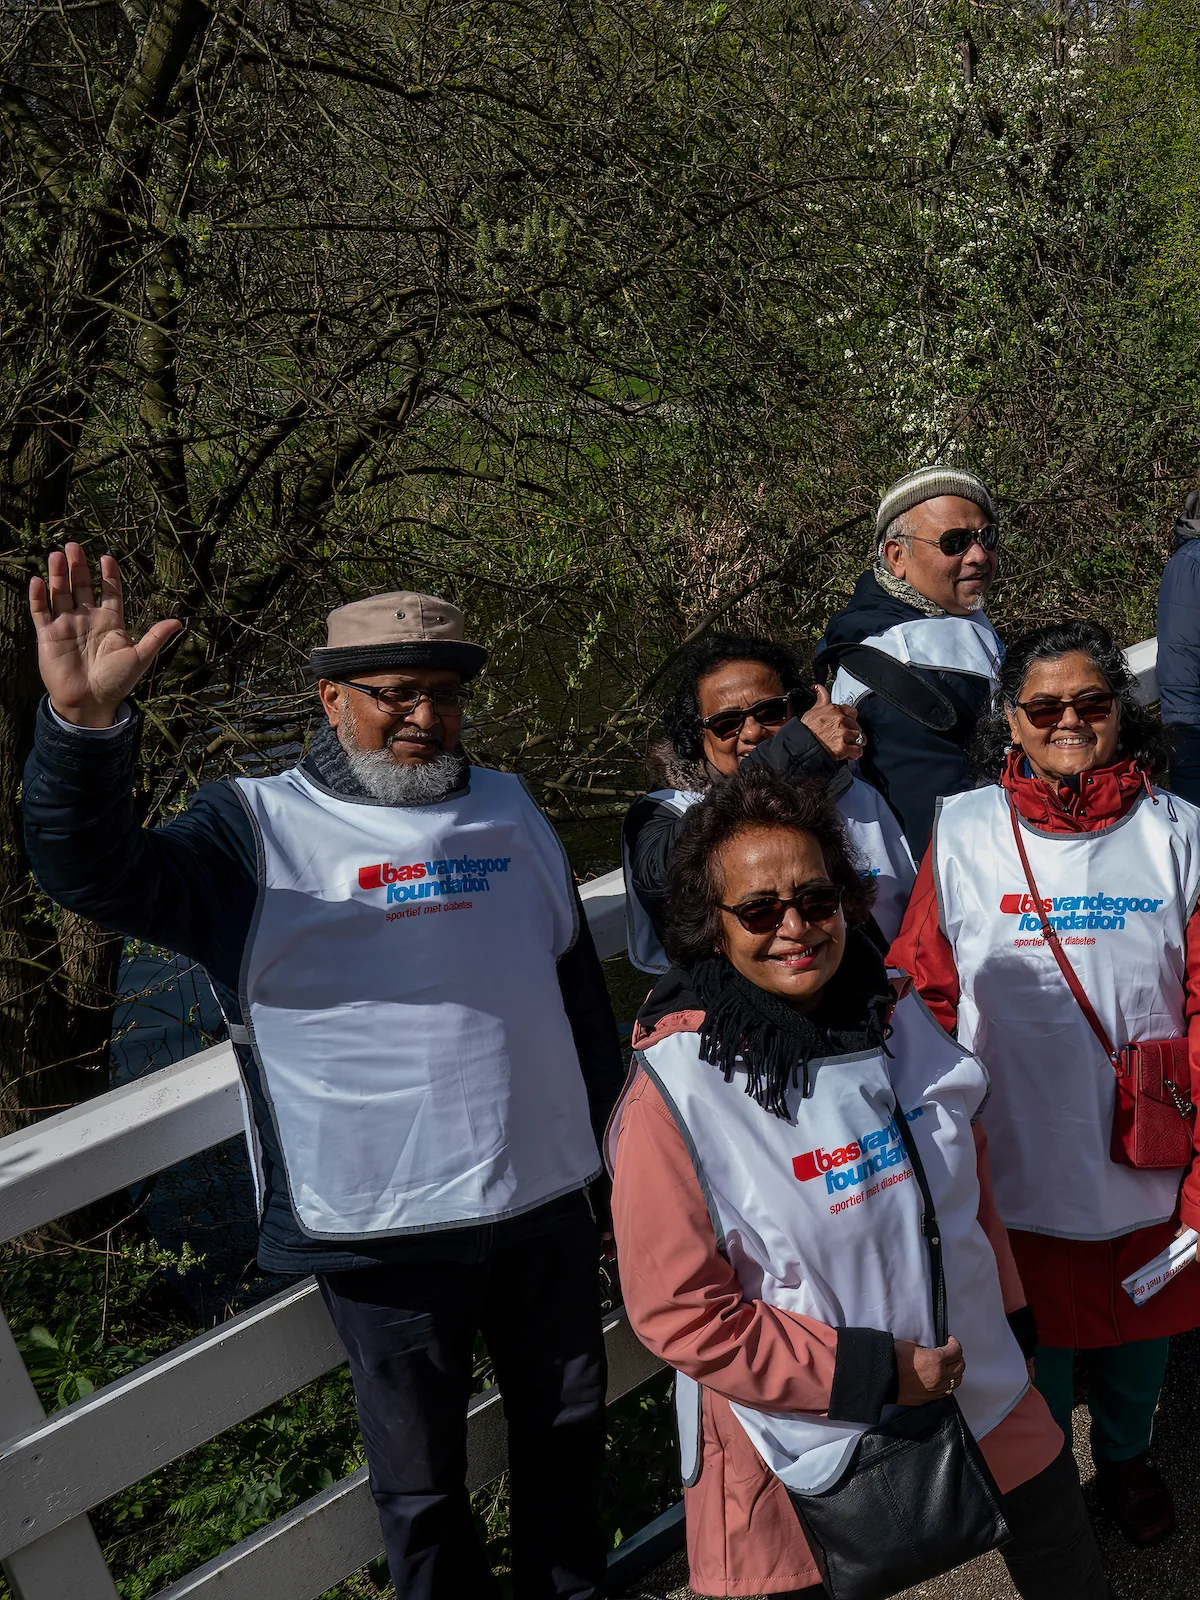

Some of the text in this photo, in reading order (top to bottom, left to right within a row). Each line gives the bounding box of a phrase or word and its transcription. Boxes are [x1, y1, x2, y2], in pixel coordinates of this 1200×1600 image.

[386, 873, 490, 904] foundation
[385, 905, 421, 922] sportief
[424, 903, 442, 915] met
[1018, 911, 1125, 931] fondation
[1065, 937, 1096, 946] diabetes
[829, 1191, 864, 1215] sportief
[866, 1183, 880, 1199] met
